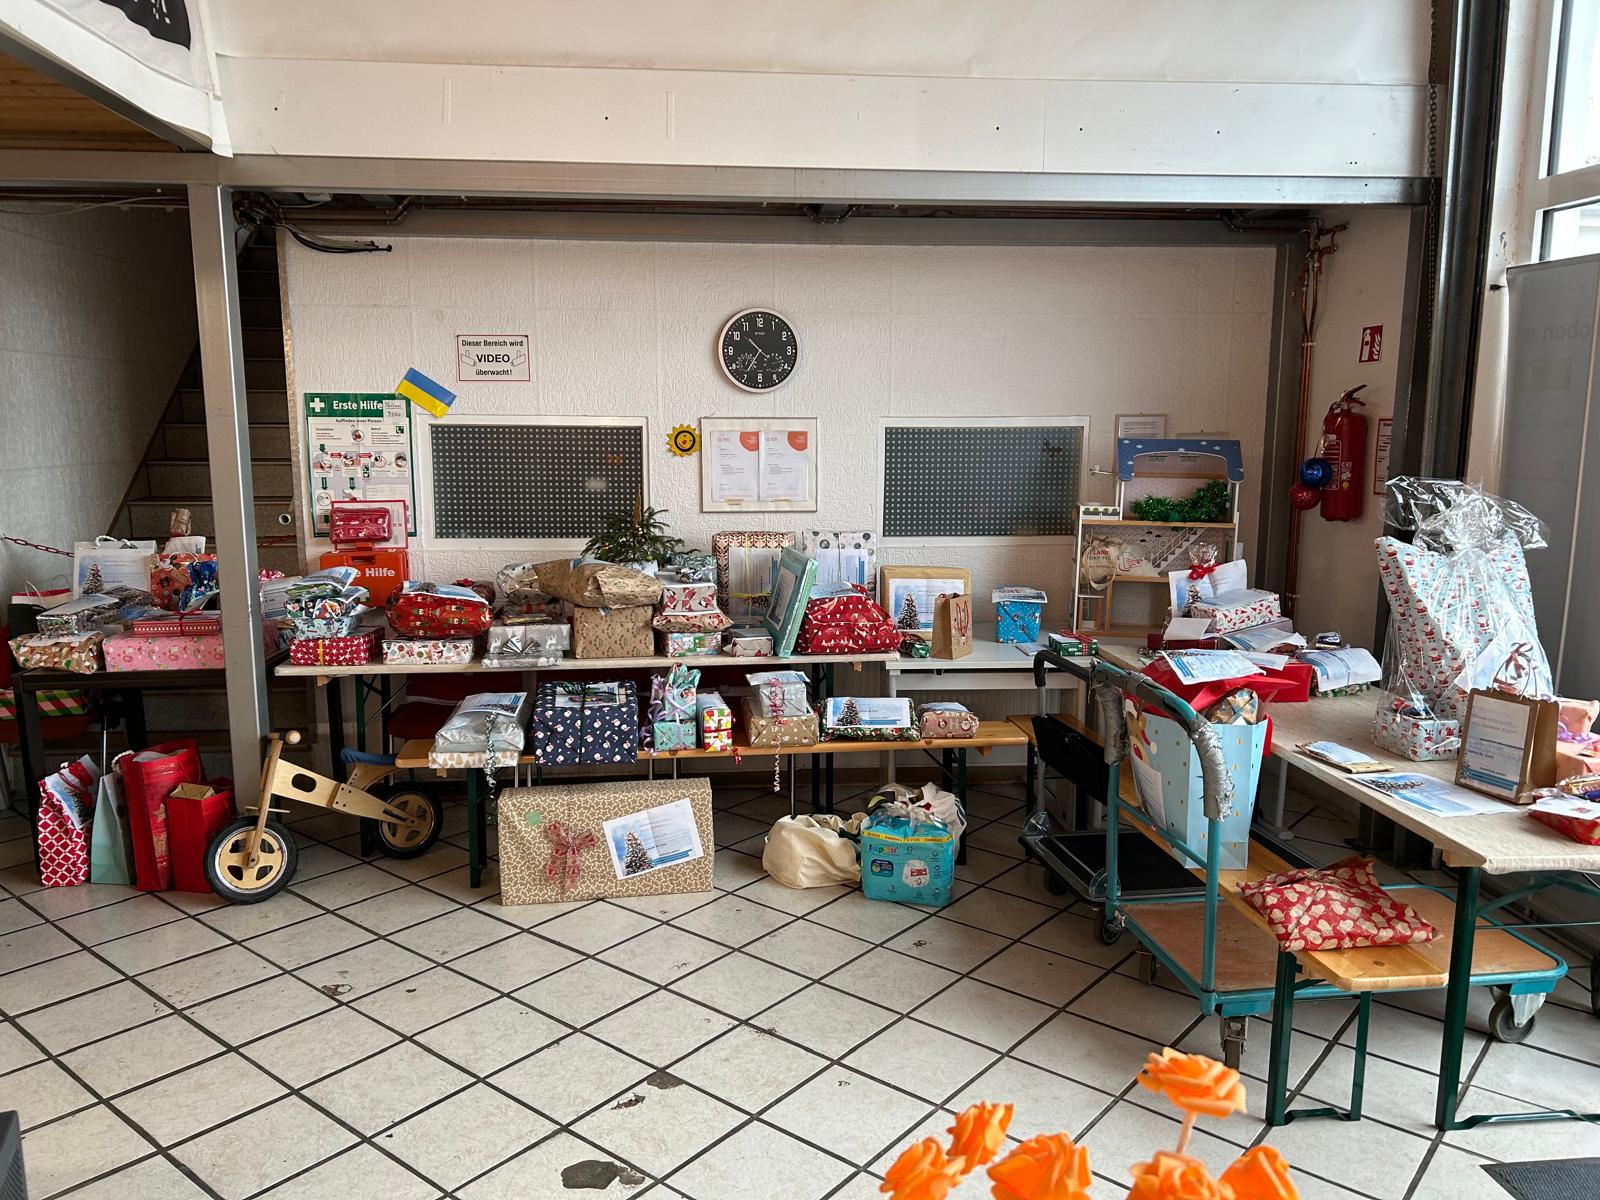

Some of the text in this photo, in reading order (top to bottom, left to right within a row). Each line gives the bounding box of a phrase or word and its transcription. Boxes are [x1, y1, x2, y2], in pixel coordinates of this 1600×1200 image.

[743, 322, 748, 331] 11
[757, 318, 763, 327] 12
[733, 332, 740, 340] 10
[782, 332, 787, 340] 2
[461, 339, 523, 347] Dieser Bereich wird
[729, 347, 733, 355] 9
[787, 346, 791, 355] 3
[476, 354, 510, 363] VIDEO
[475, 368, 512, 376] überwacht!
[758, 374, 762, 382] 6
[333, 400, 383, 410] Erste Hilfe
[365, 568, 395, 577] Hilfe
